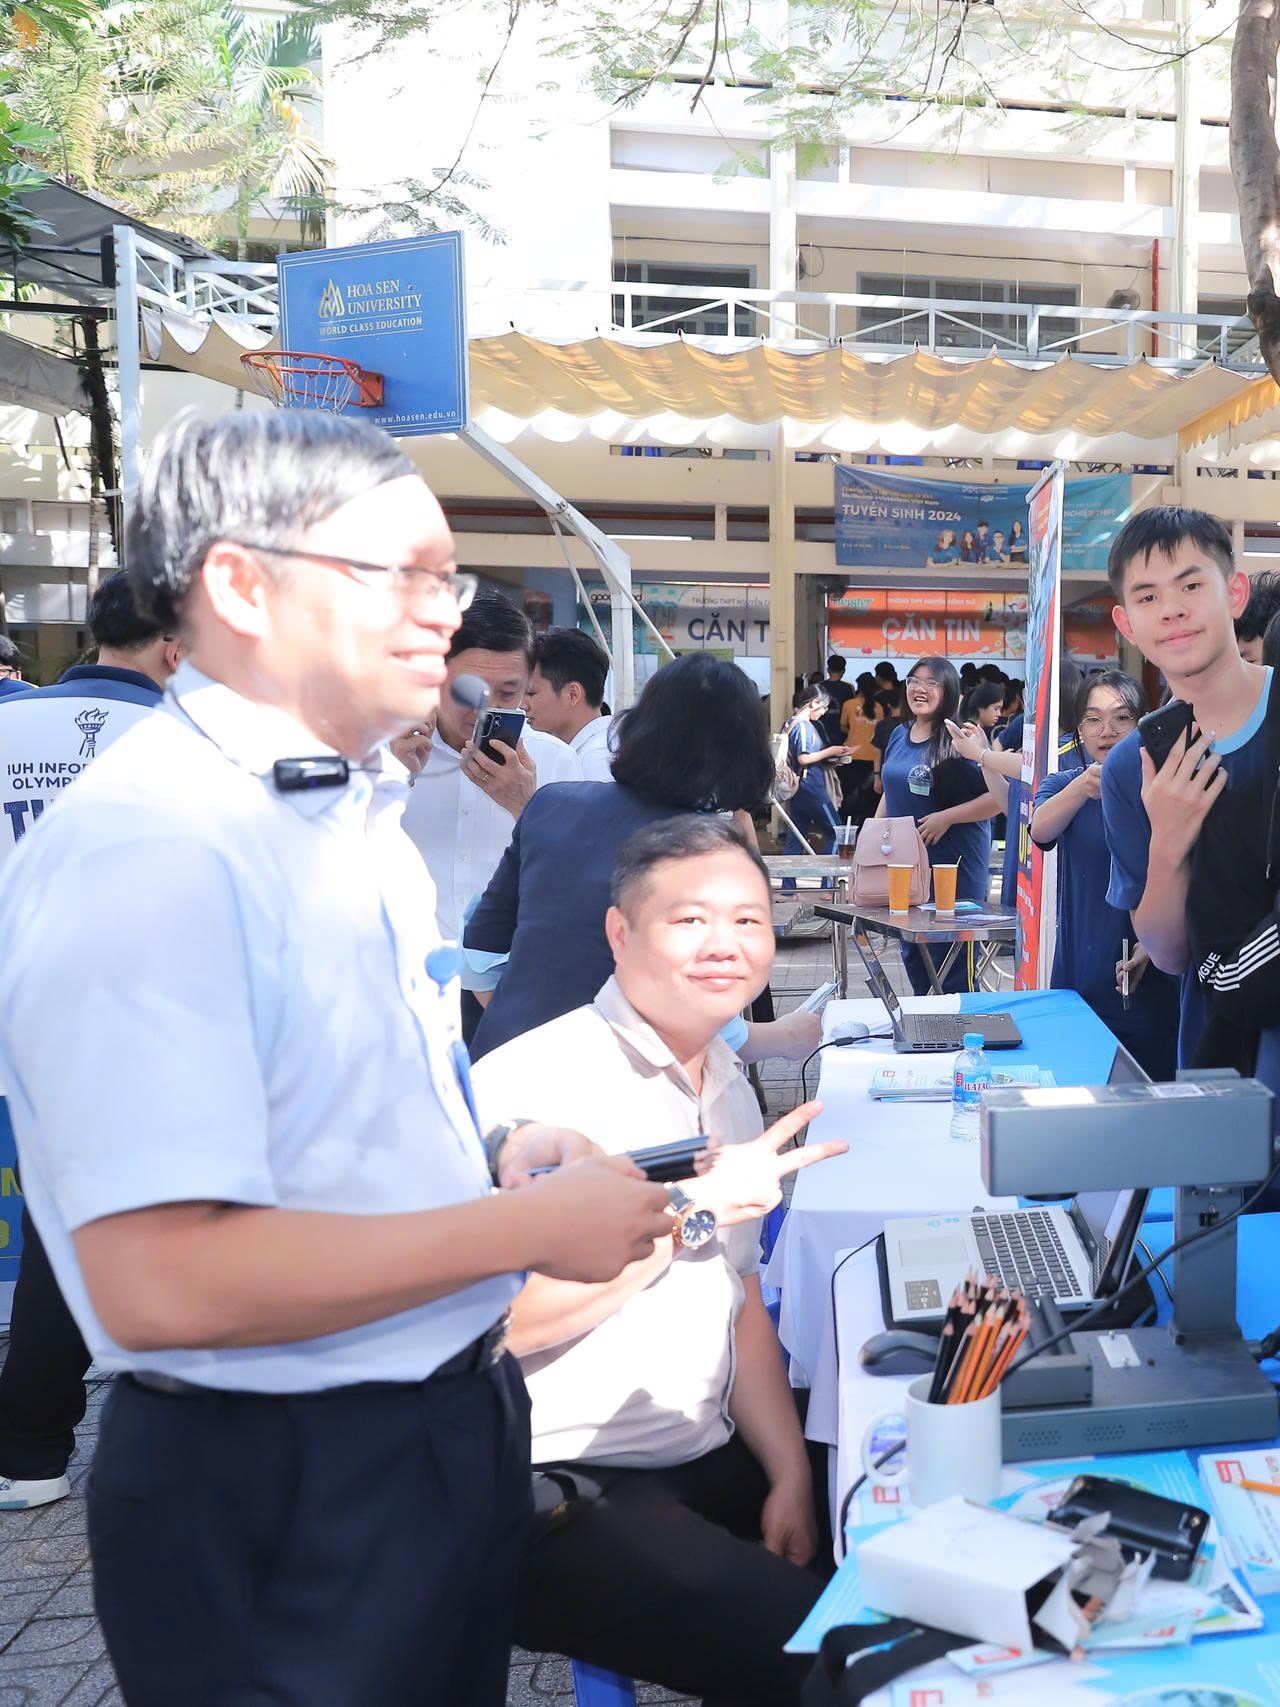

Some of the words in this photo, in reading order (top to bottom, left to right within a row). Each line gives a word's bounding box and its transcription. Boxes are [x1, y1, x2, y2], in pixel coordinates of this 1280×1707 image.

[347, 283, 373, 298] HOA
[375, 280, 401, 295] SEN
[347, 294, 423, 316] UNIVERSITY
[319, 325, 347, 336] WORLD
[349, 322, 374, 333] CLASS
[376, 316, 422, 330] EDUCATION
[374, 410, 456, 424] www.hoasen.edu.vn
[841, 501, 888, 518] TUYỂN
[891, 508, 925, 520] SINH
[927, 510, 961, 522] 2024
[688, 612, 746, 642] CĂN
[881, 613, 936, 641] CĂN
[943, 618, 981, 642] TIN
[7, 762, 34, 776] IUH
[39, 762, 88, 774] INFO
[12, 776, 76, 790] OLYMP
